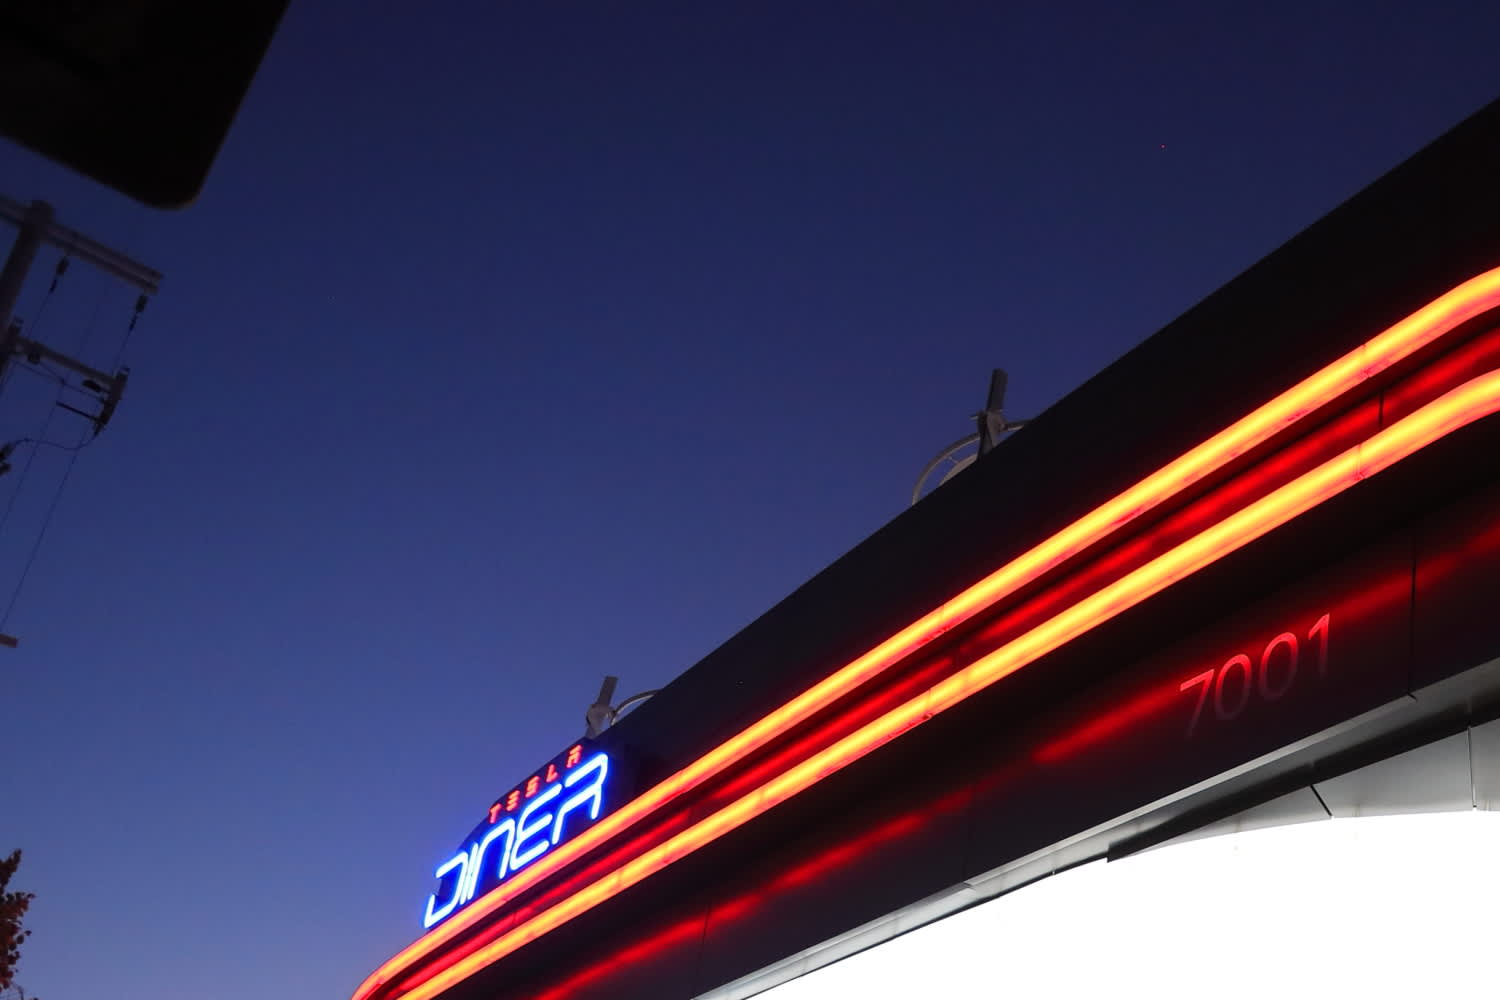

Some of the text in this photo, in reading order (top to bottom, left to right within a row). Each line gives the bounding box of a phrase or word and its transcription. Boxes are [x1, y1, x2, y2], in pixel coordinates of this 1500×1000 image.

[1179, 613, 1330, 738] 7001
[423, 751, 610, 930] DINER
[488, 744, 584, 824] TESLA
